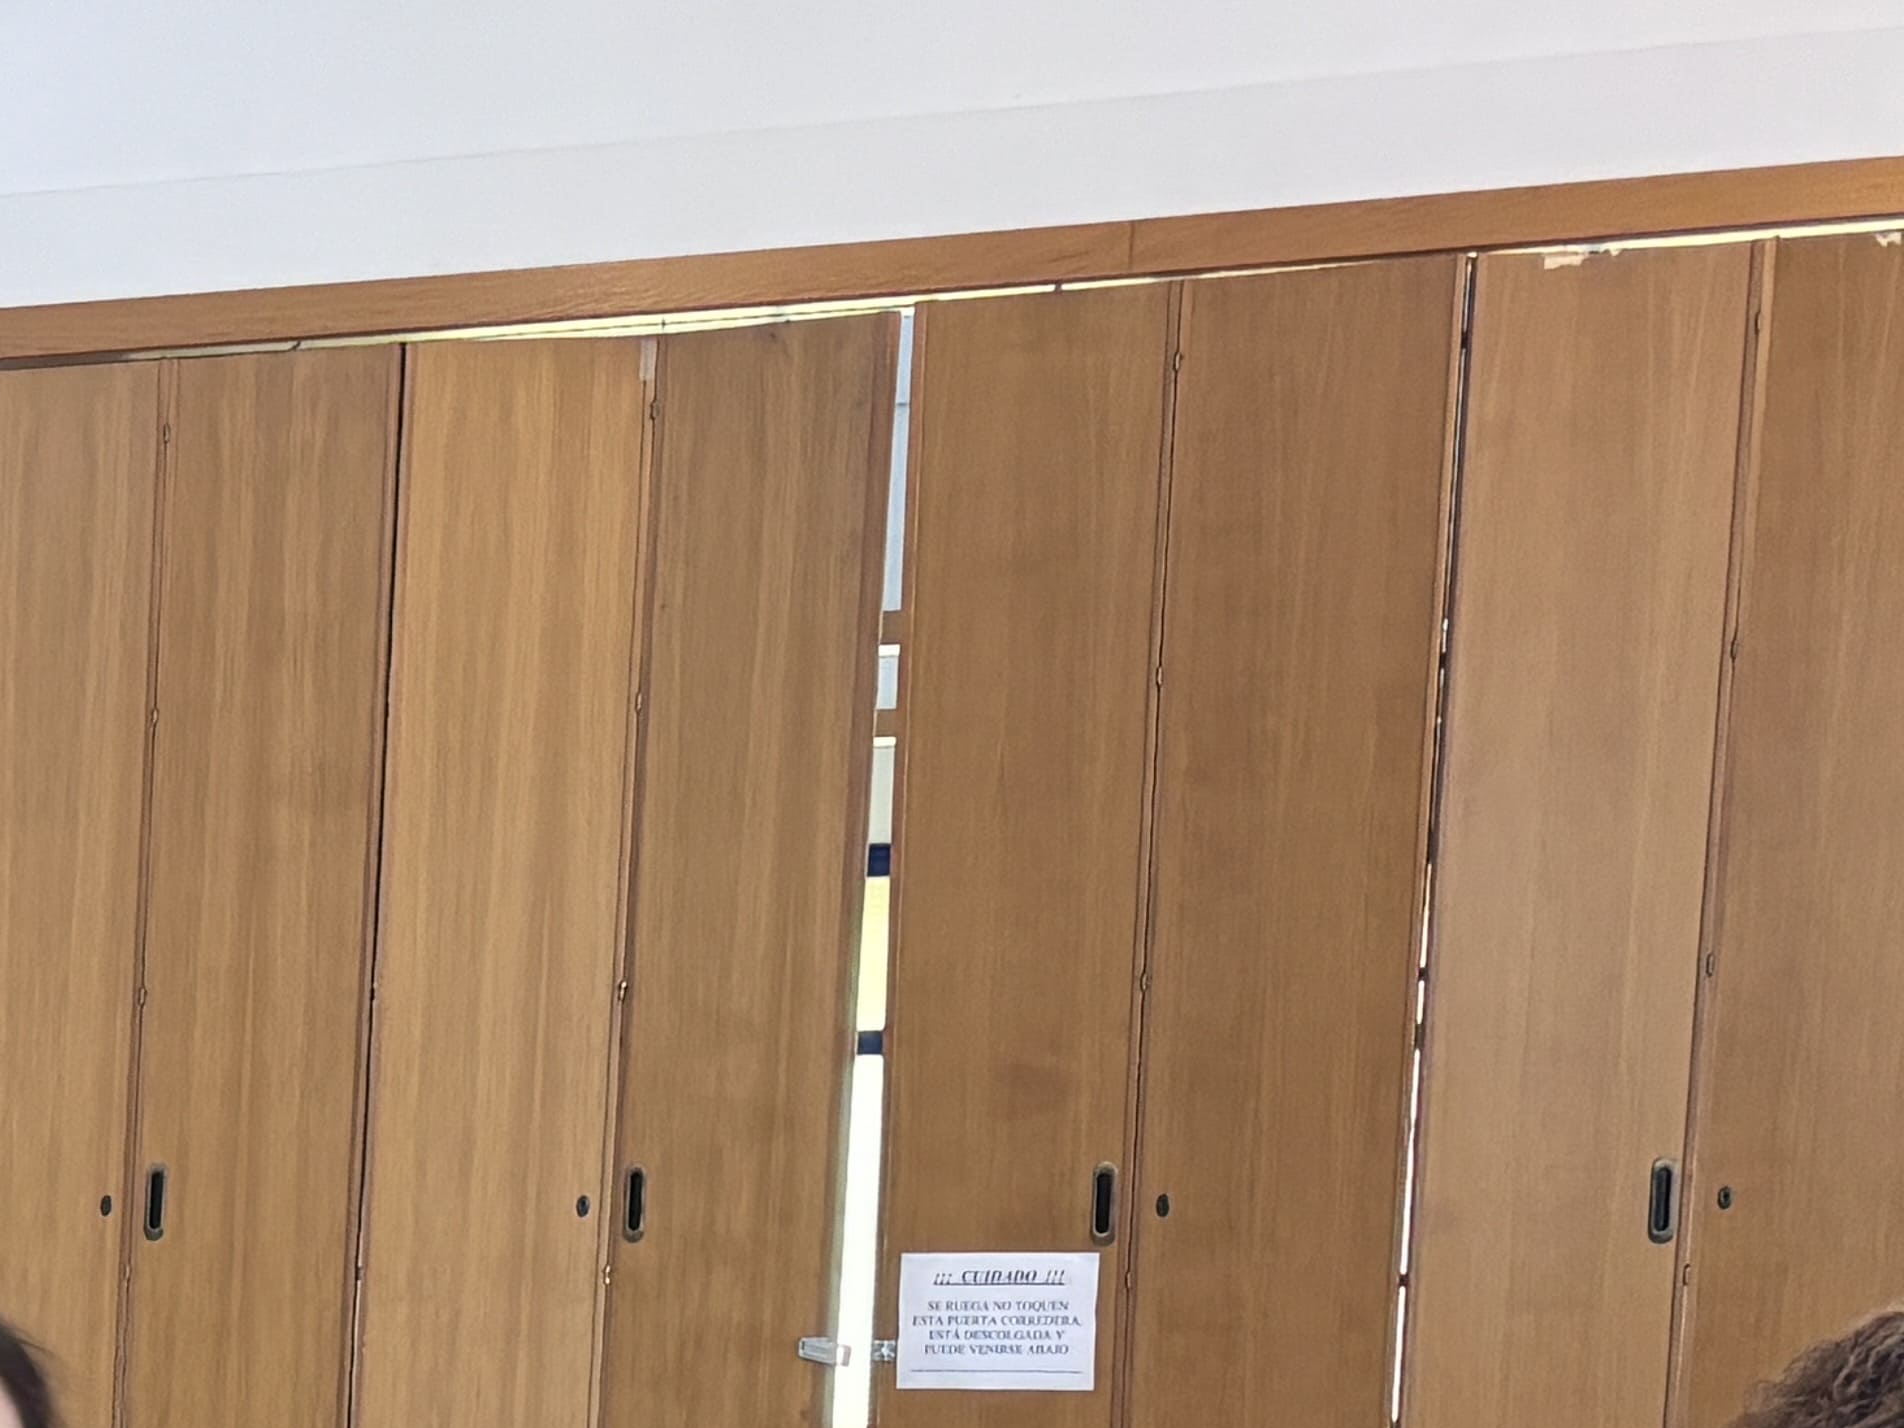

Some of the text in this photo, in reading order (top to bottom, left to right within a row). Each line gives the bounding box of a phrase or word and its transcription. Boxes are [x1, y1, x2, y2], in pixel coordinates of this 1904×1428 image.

[961, 1269, 1037, 1284] CUIDADO
[927, 1300, 1069, 1313] SE RUEGA NO TOQUEN
[912, 1315, 943, 1326] ESTA
[947, 1315, 997, 1326] PUERTA
[964, 1330, 1052, 1341] DESCOLGADA
[1056, 1330, 1066, 1341] Y
[924, 1344, 1070, 1355] PUEDE VENIRSE ABAJO
